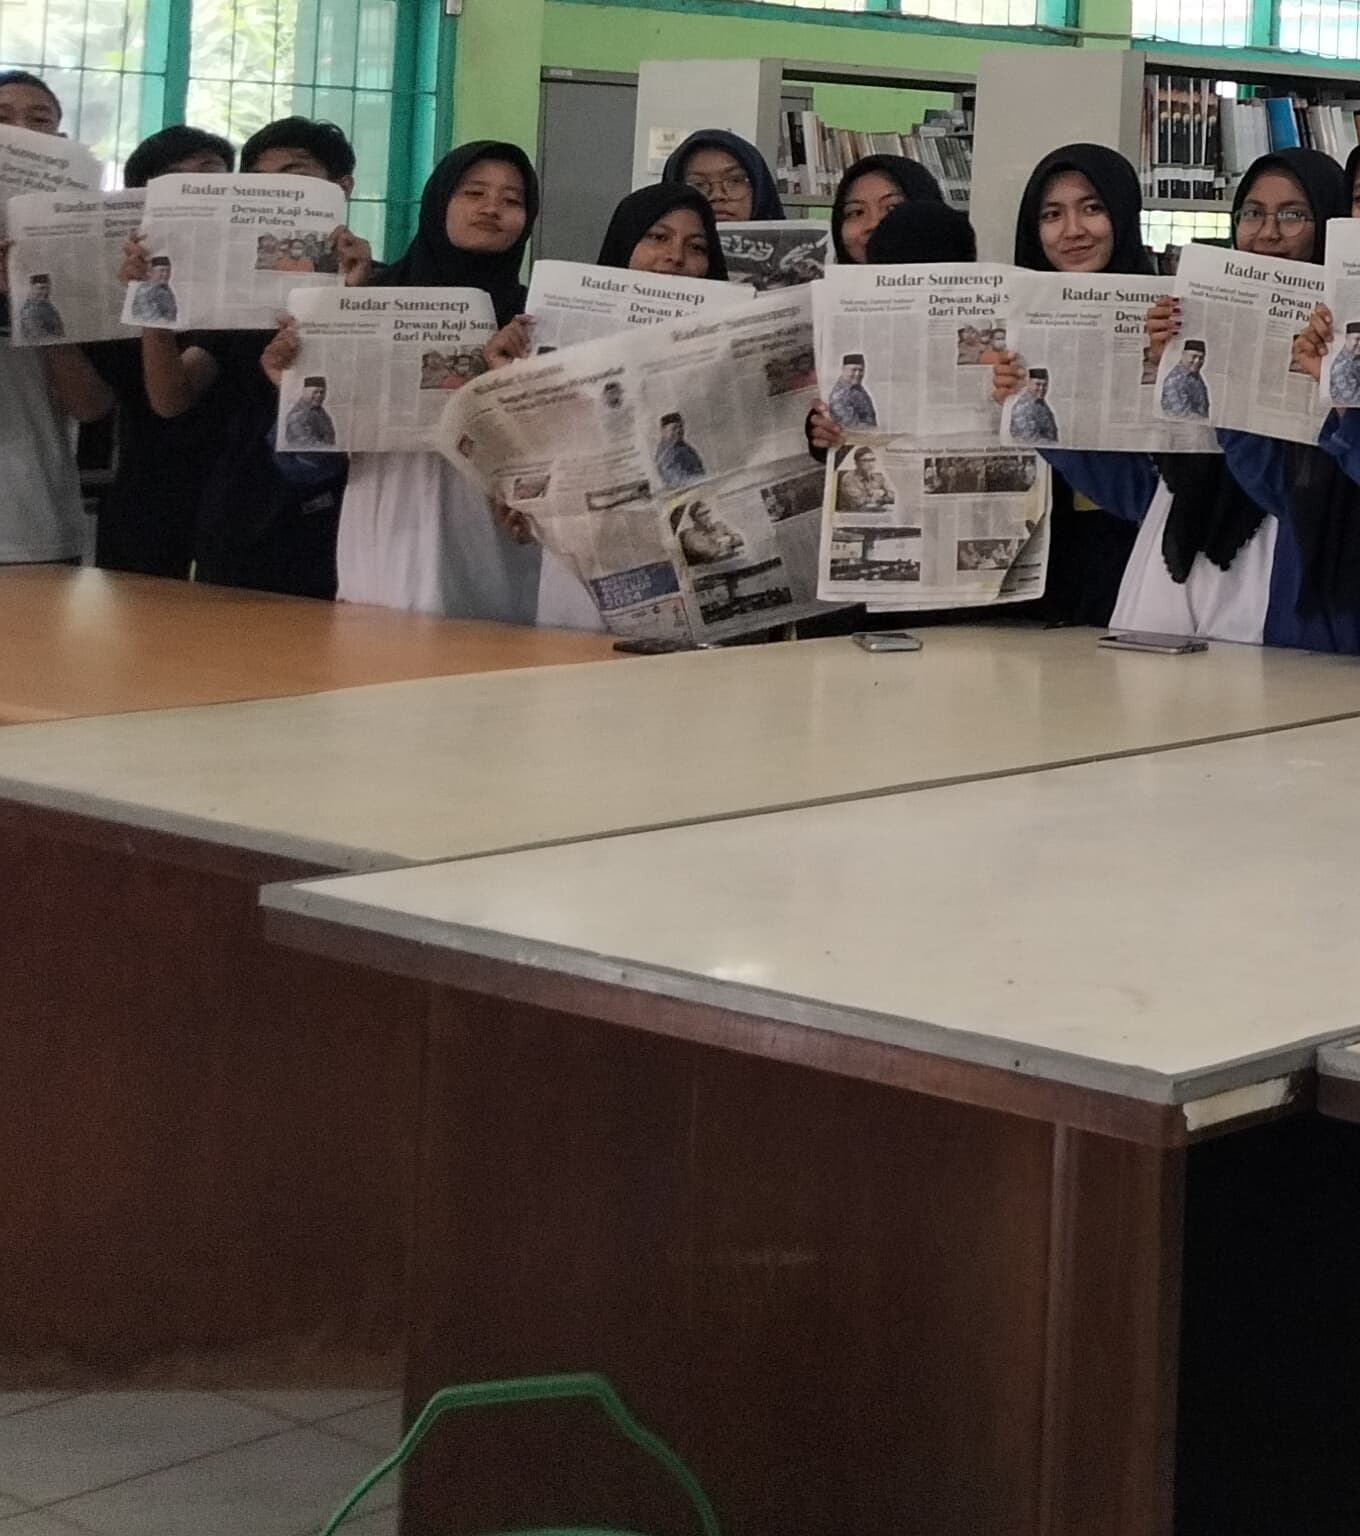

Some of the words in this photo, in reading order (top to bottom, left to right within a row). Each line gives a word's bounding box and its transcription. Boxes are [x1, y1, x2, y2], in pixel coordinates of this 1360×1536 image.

[876, 274, 925, 287] Radar
[928, 273, 1004, 288] Sumenep
[1224, 261, 1270, 281] Radar
[1273, 270, 1325, 292] Sumen
[581, 275, 630, 293] Radar
[632, 281, 705, 306] Sumenep
[1062, 288, 1112, 301] Radar
[928, 294, 973, 305] Dewan
[975, 294, 1001, 306] Kaji
[1271, 292, 1312, 309] Dewan
[927, 306, 954, 316] dari
[957, 306, 996, 316] Polres
[1115, 311, 1147, 322] Dew
[1268, 305, 1294, 319] dari
[1114, 323, 1140, 334] dari
